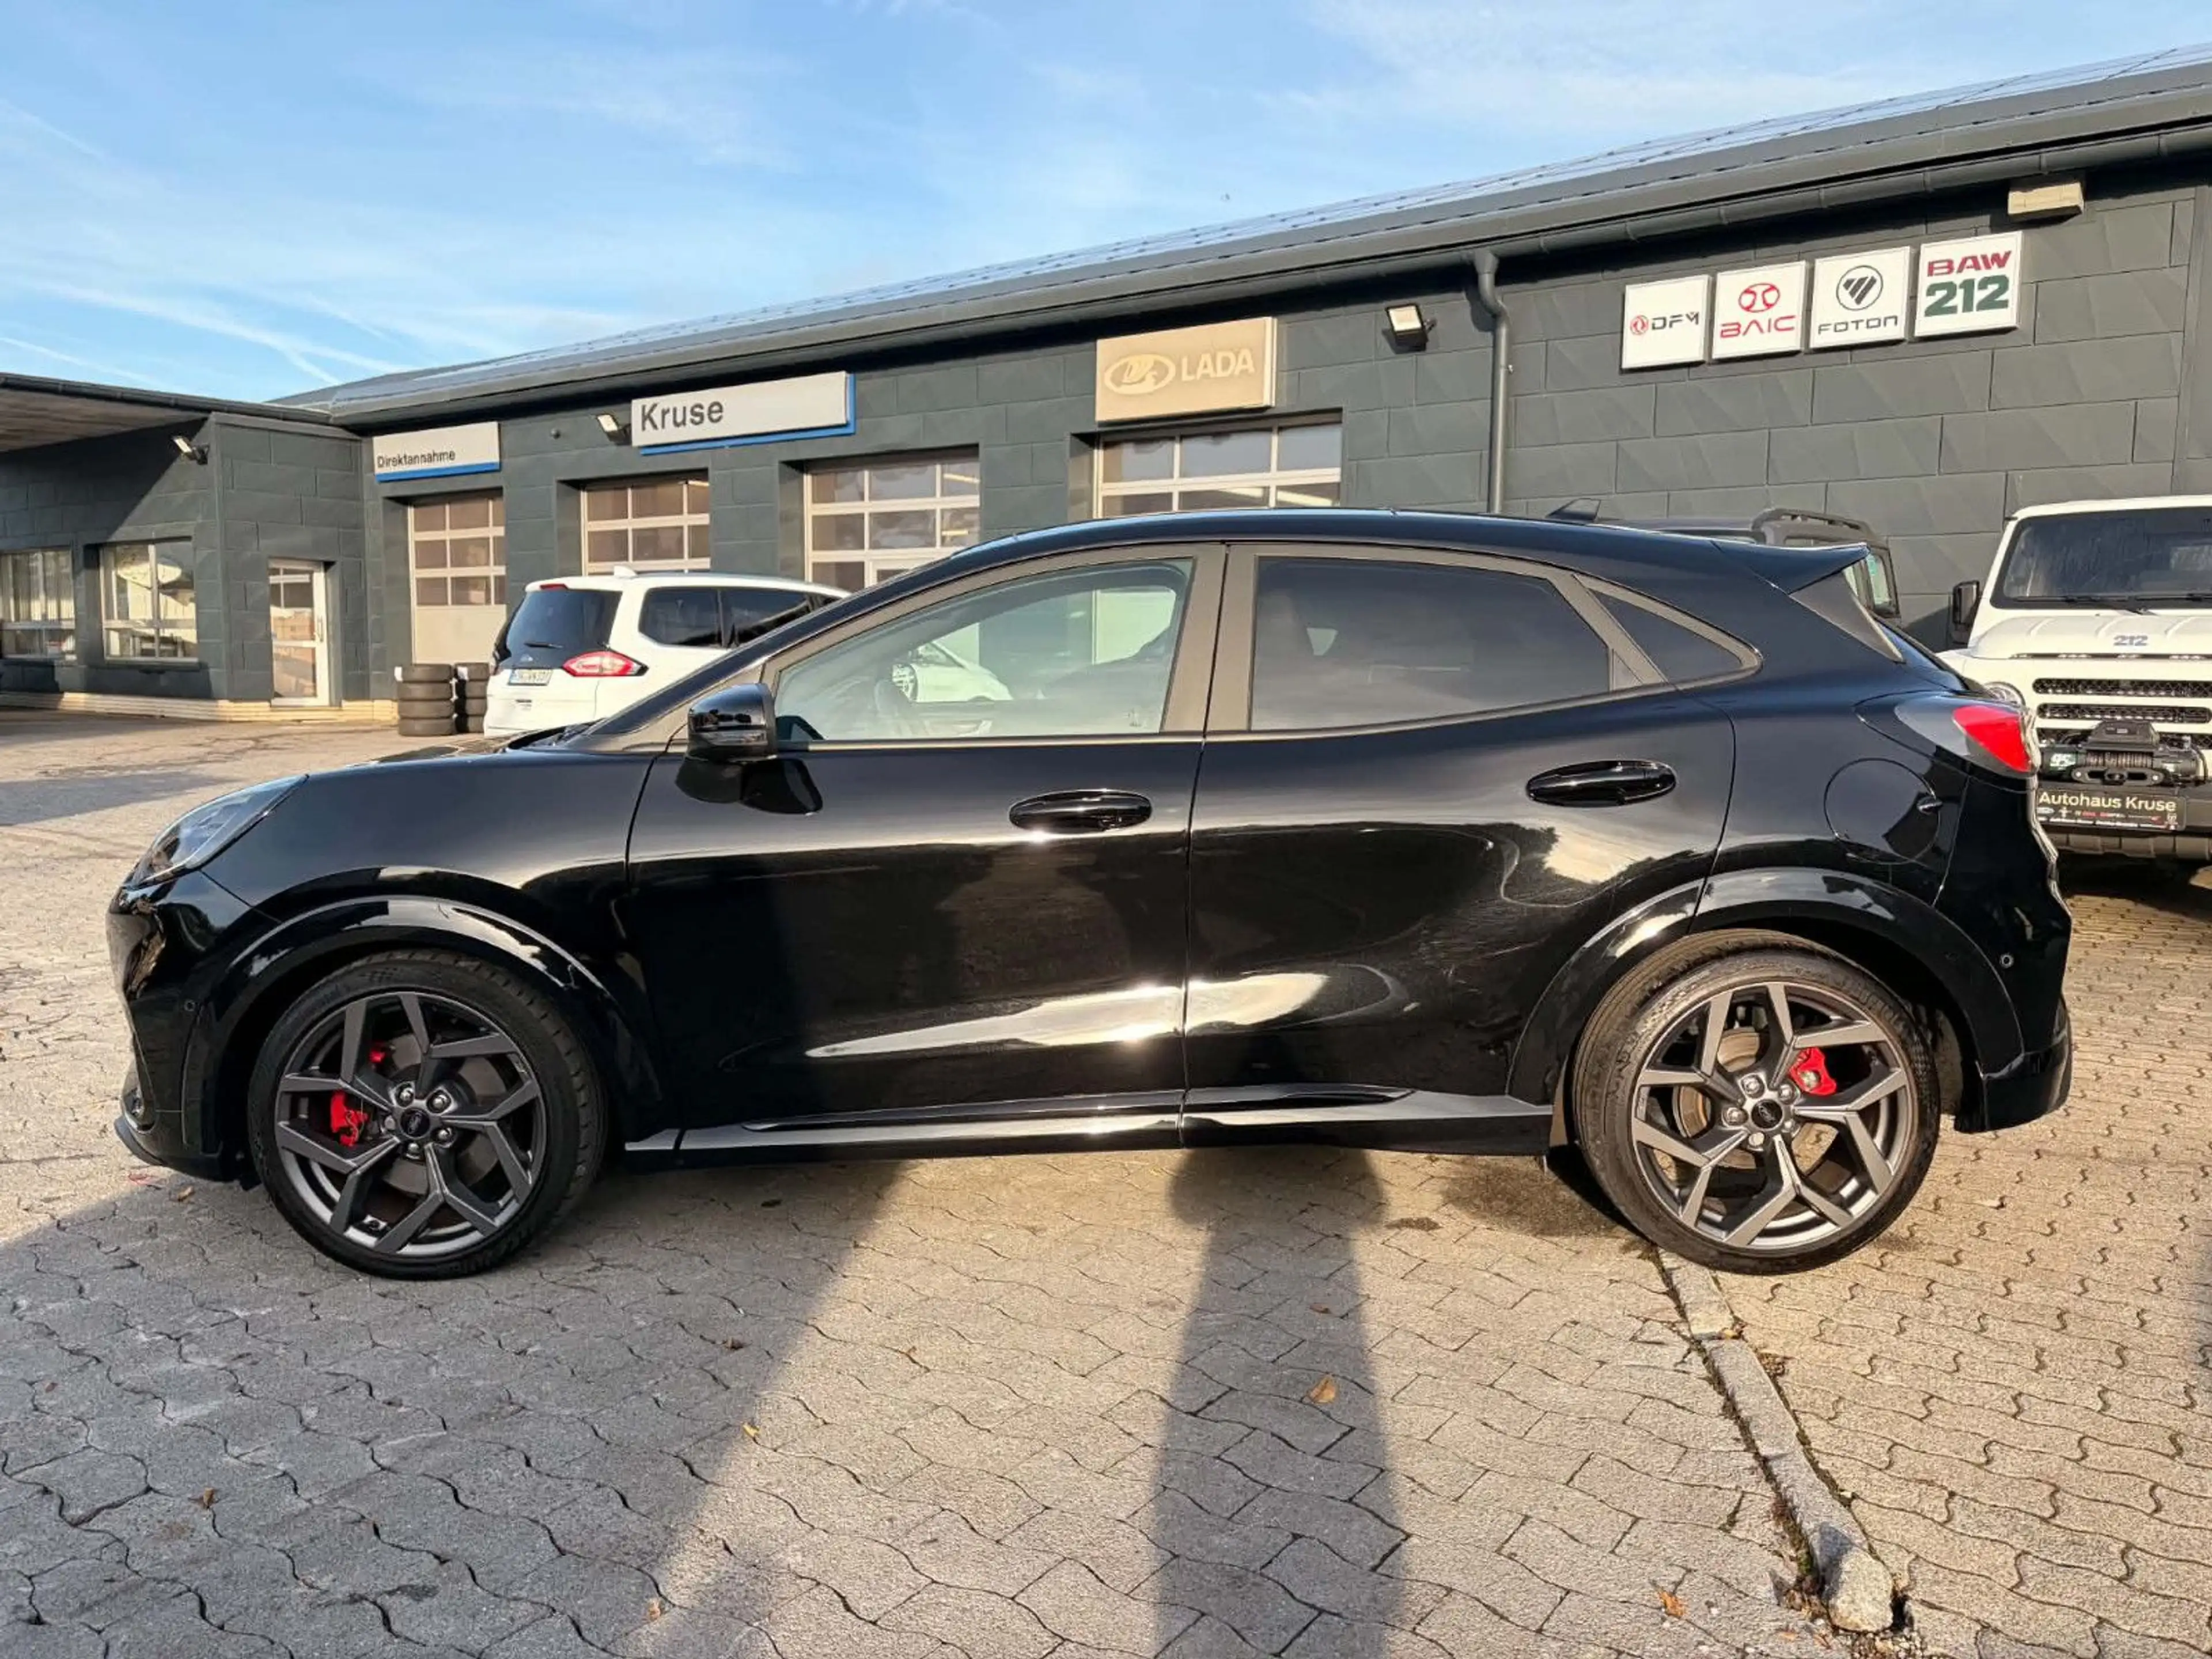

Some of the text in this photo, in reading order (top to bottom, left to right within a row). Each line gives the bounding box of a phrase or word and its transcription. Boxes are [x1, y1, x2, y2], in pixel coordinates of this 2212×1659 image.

[1927, 251, 2012, 276] BAW
[1924, 274, 2010, 317] 212
[1651, 312, 1699, 331] DFM
[1719, 315, 1796, 338] BAIC
[1817, 315, 1898, 335] FOTON
[1181, 348, 1255, 381] LADA
[641, 401, 724, 431] Kruse
[377, 450, 456, 468] Direktannahme
[2113, 635, 2148, 646] 212
[2039, 791, 2177, 812] Autohaus Kruse
